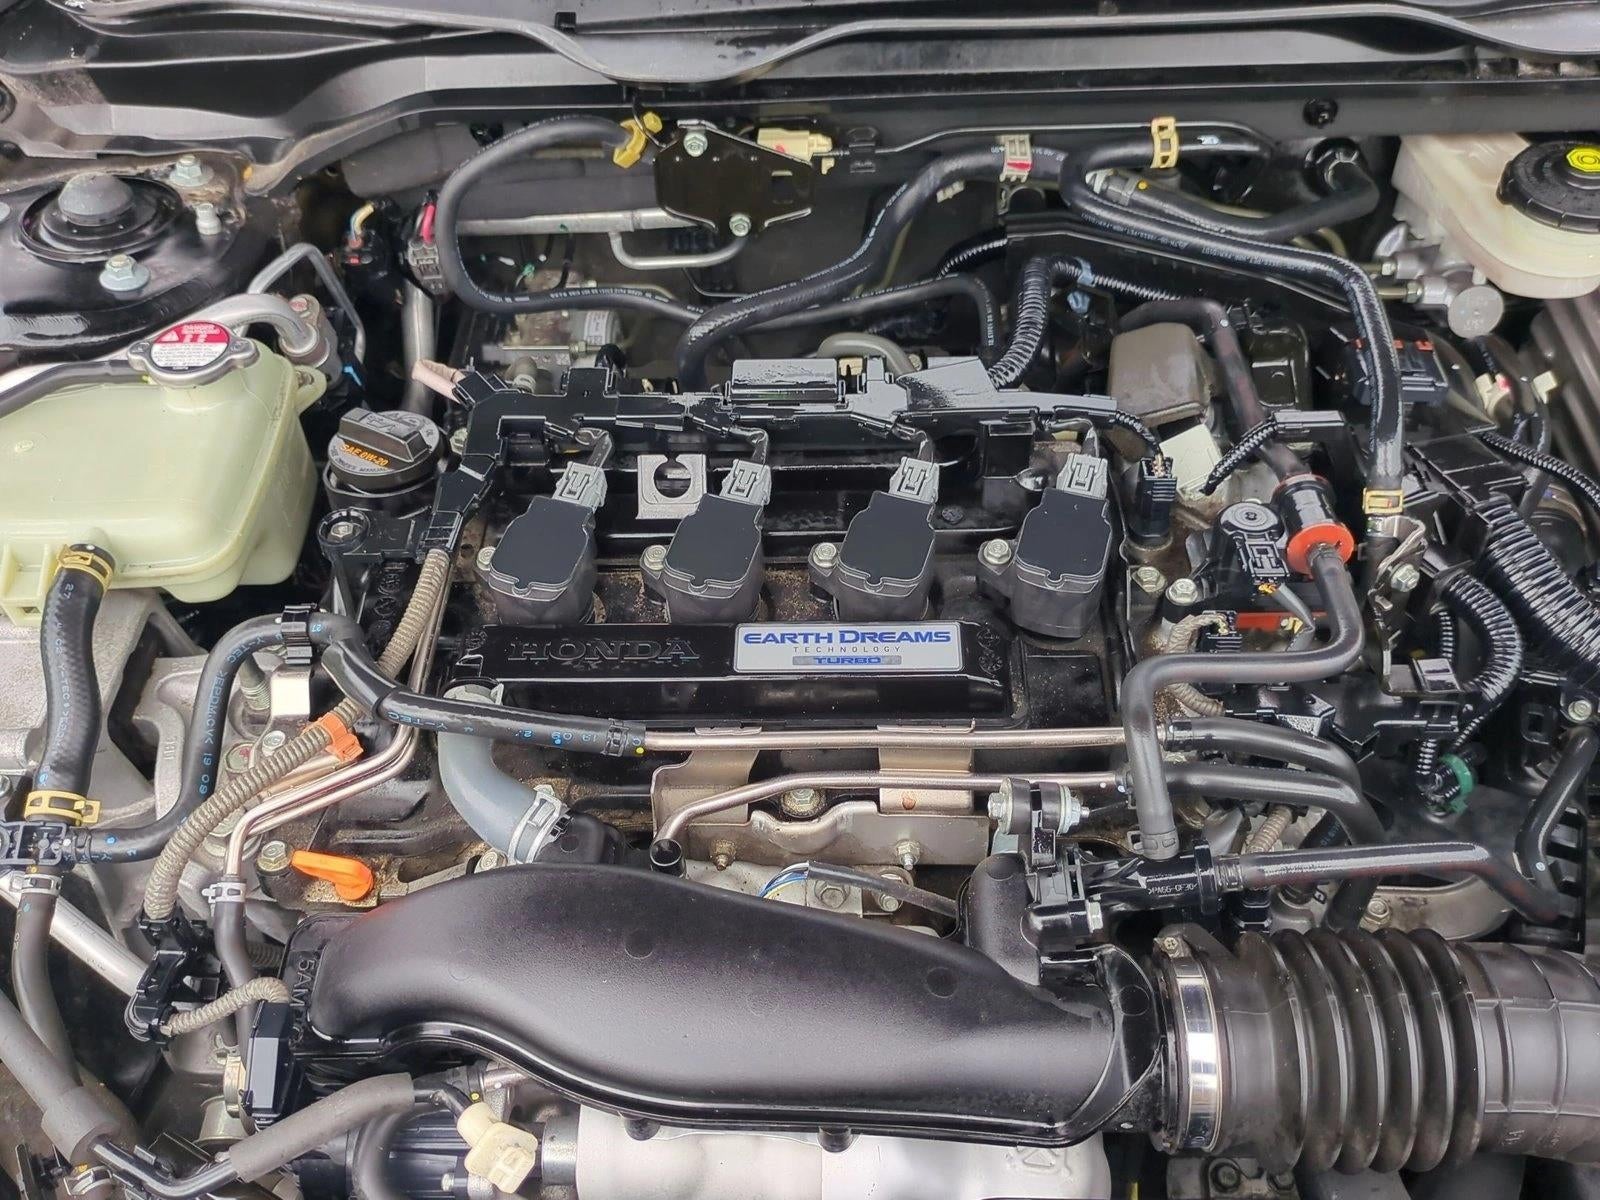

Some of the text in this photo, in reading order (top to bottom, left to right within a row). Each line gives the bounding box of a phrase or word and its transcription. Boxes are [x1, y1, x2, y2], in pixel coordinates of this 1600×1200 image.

[341, 444, 360, 456] SAE
[743, 630, 951, 644] EARTH DREAMS
[226, 634, 265, 664] Y-TEC
[507, 638, 700, 661] HONDA
[813, 656, 882, 664] TURBO
[387, 711, 448, 730] Y-TEC
